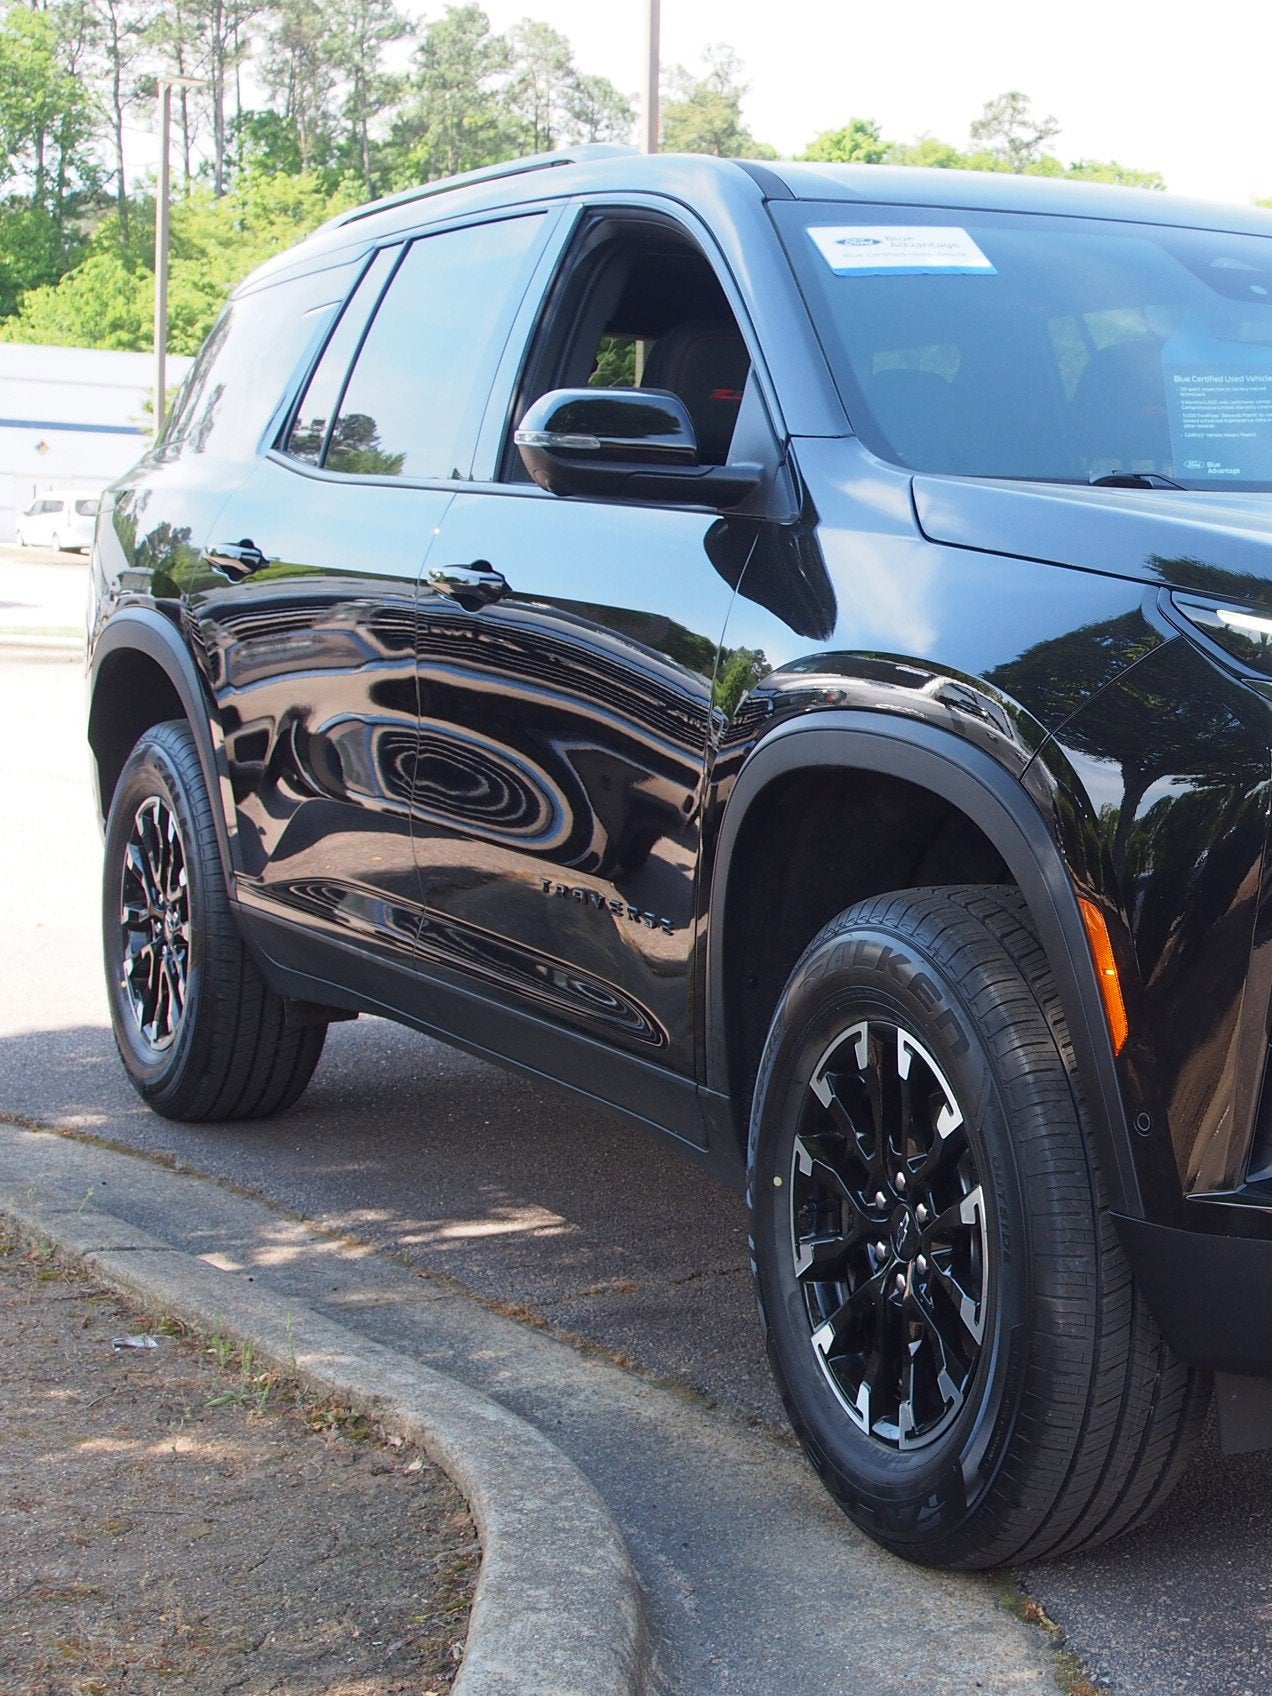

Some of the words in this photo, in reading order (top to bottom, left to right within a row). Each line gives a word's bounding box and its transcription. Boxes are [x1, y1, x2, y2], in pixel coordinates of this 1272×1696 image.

[1173, 375, 1190, 383] Blue
[1191, 375, 1224, 383] Certified
[1225, 375, 1245, 383] Used
[1246, 374, 1272, 382] Vehicle
[538, 877, 674, 936] TRAVERSE
